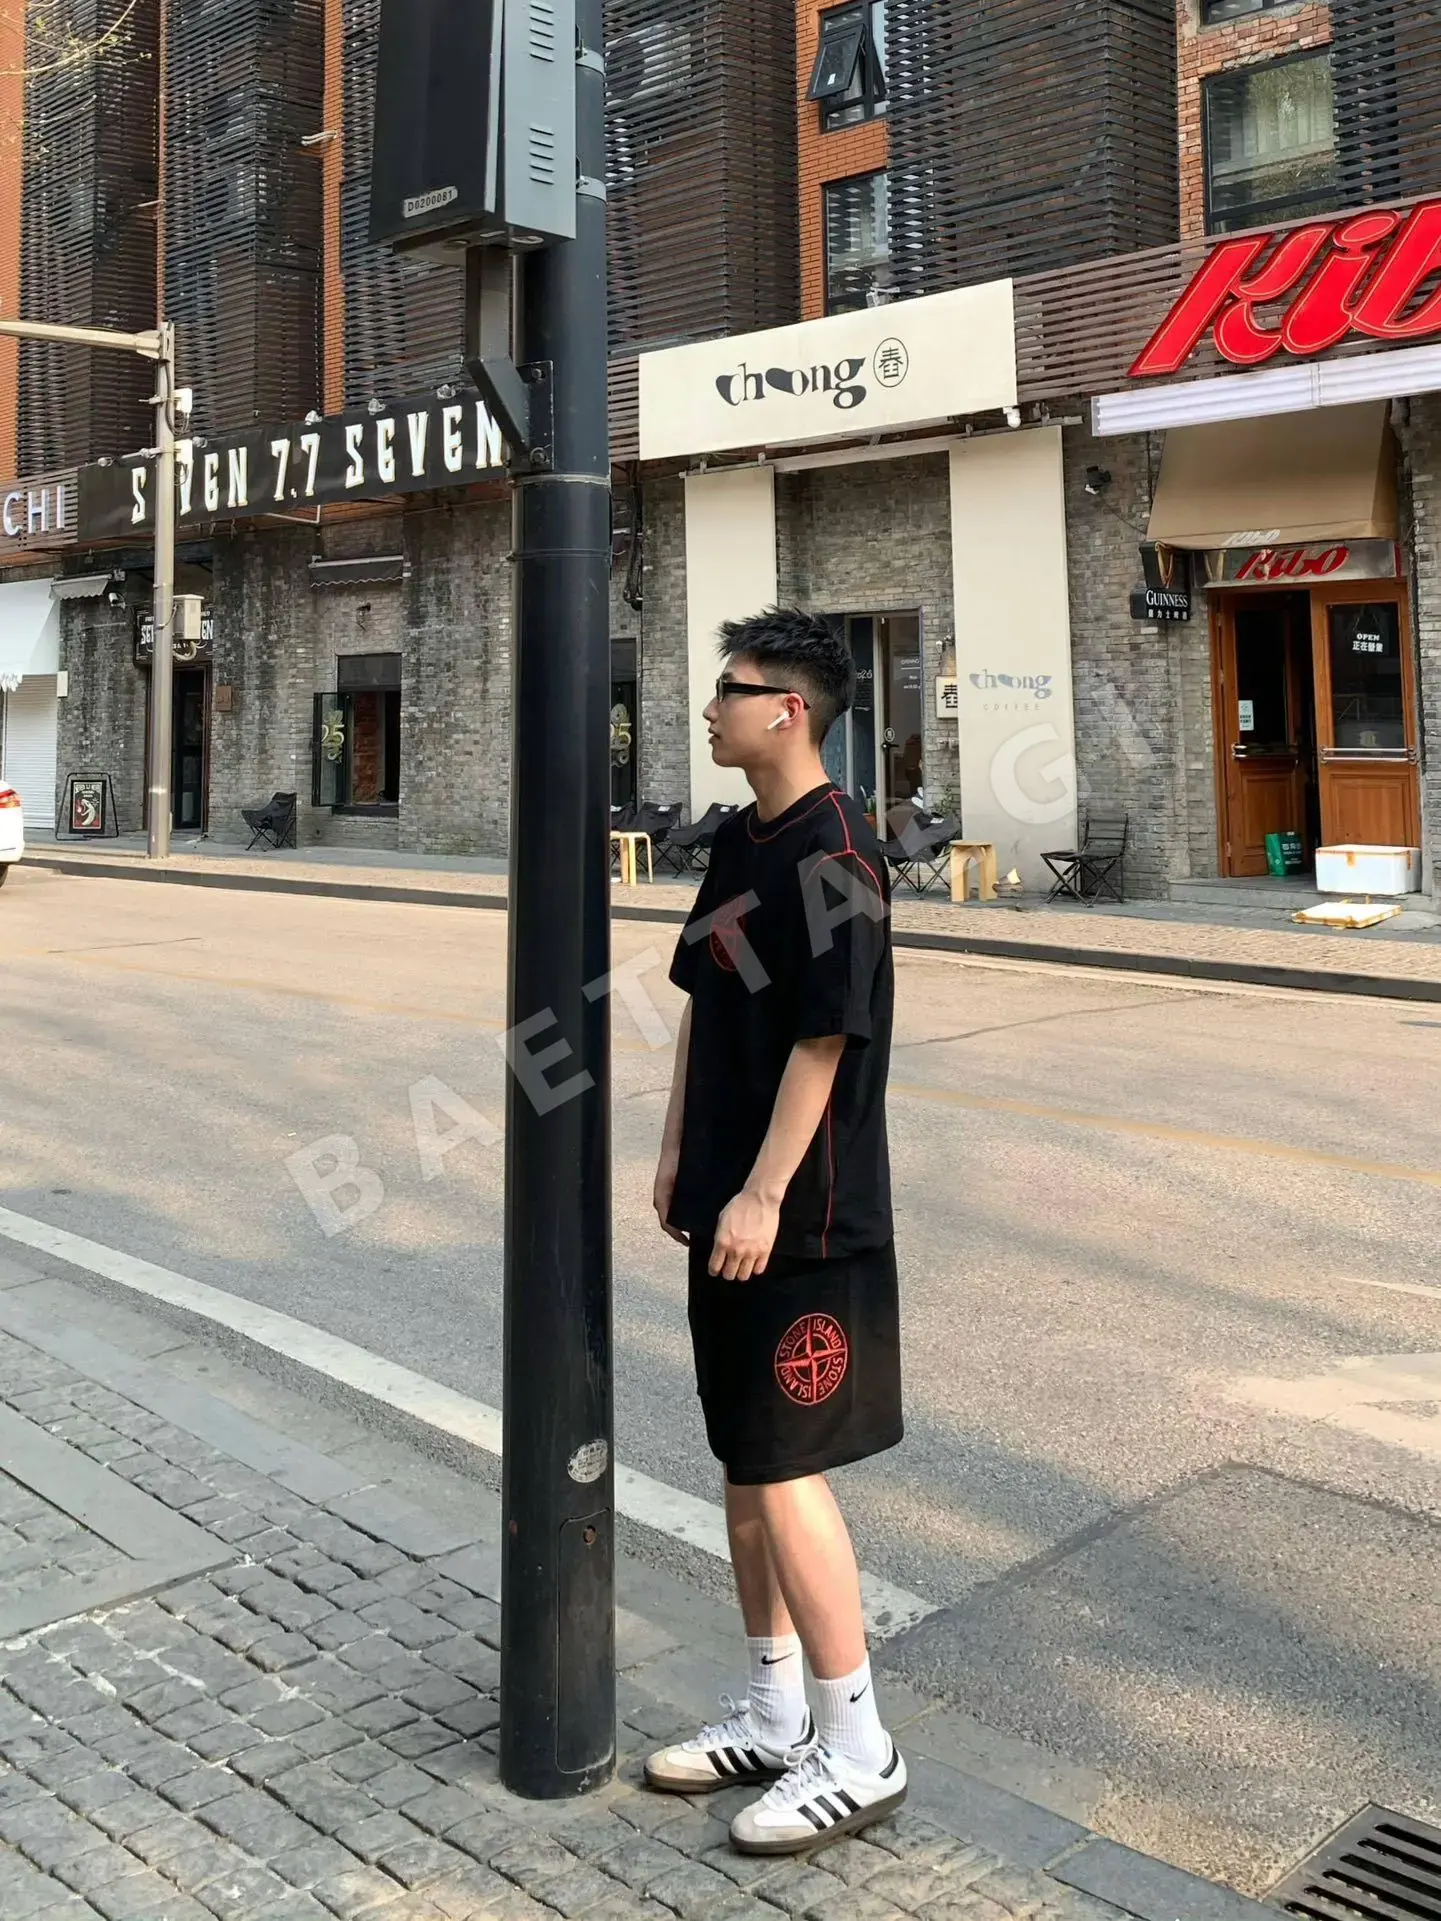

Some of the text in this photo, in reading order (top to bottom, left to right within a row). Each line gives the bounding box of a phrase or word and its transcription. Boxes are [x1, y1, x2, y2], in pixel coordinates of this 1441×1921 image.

[408, 190, 453, 211] D0200081
[131, 400, 503, 526] SVEN 7.7 SEVEN
[3, 485, 66, 537] CHI
[1146, 589, 1189, 607] GUINNESS
[1356, 632, 1380, 642] OPEN
[779, 1317, 842, 1358] STONE ISLAND
[780, 1356, 844, 1399] STONE ISLAND
